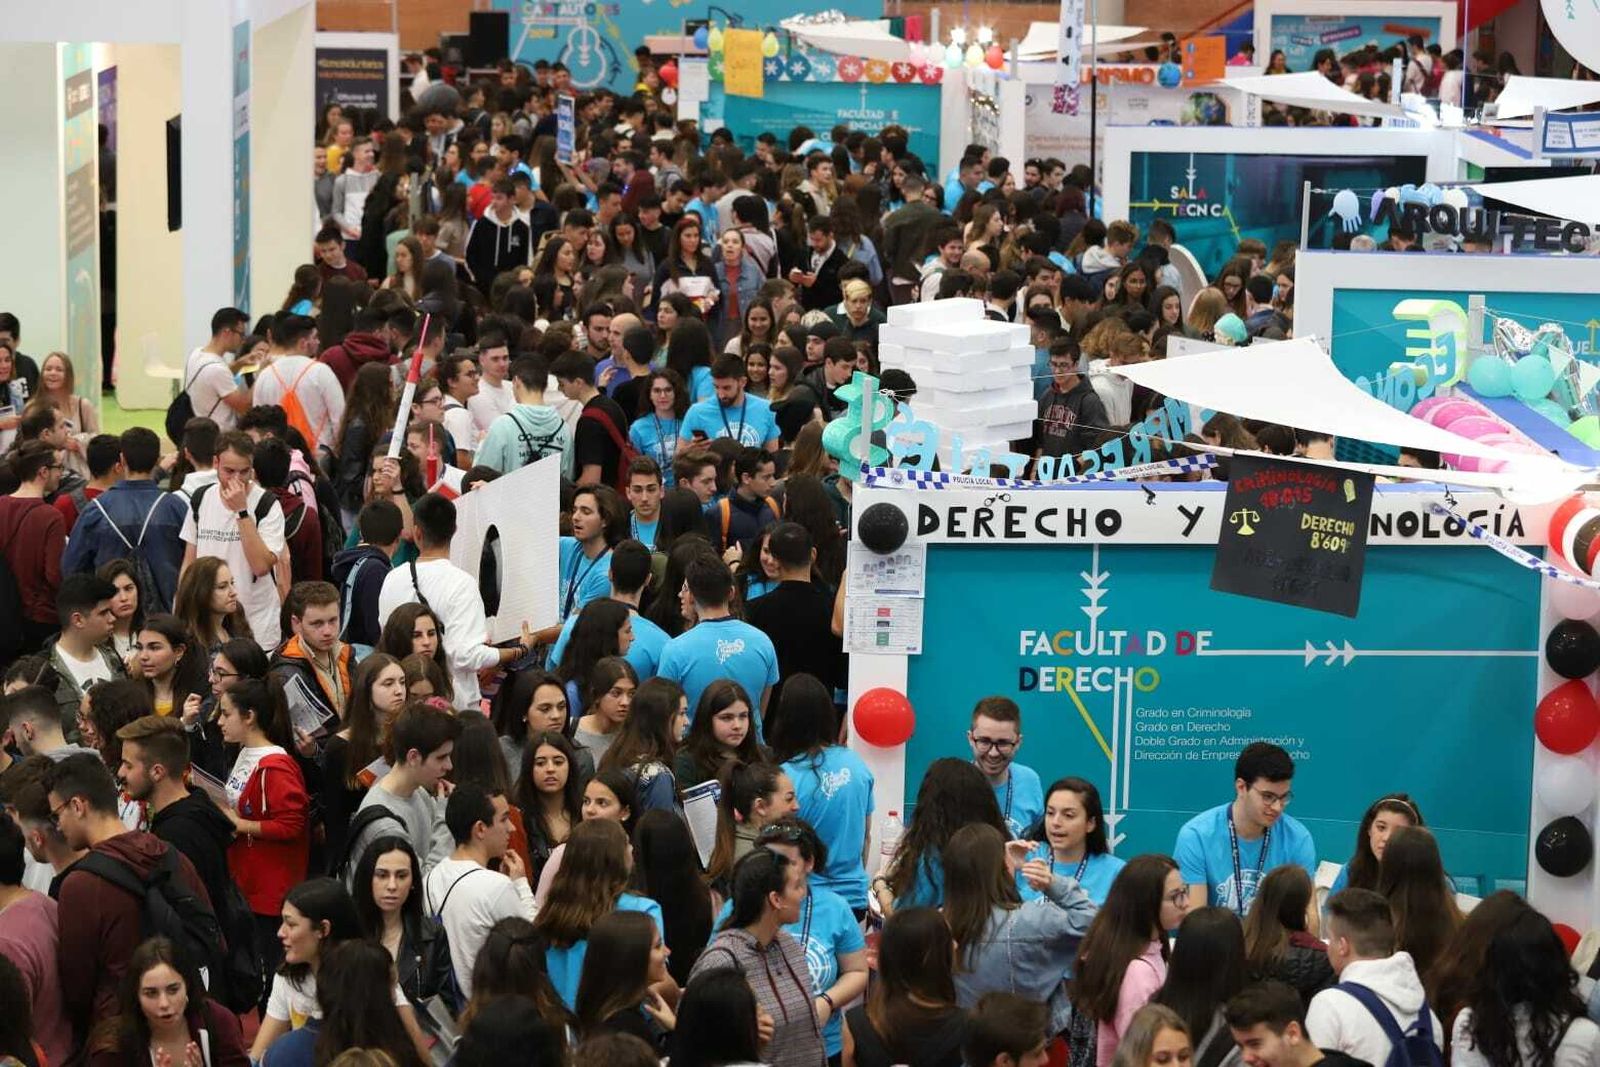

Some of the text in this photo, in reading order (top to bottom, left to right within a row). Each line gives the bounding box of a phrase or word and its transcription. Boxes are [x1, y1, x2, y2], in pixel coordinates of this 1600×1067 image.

[1171, 186, 1207, 199] SALA
[1370, 197, 1600, 253] ARQUITEC
[917, 503, 1525, 538] DERECHO Y NOLOGÍA
[1301, 512, 1355, 536] DERECHO
[1020, 630, 1213, 656] FACULTAD DE
[1019, 666, 1161, 692] DERECHO
[1136, 707, 1168, 717] Grado
[1135, 721, 1231, 732] Grado en Derecho
[1135, 736, 1165, 746] Doble
[1168, 736, 1201, 746] Grado
[1203, 738, 1217, 746] en
[1298, 738, 1304, 748] y
[1134, 749, 1183, 760] Dirección
[1185, 750, 1199, 760] de
[1201, 750, 1240, 762] Empres
